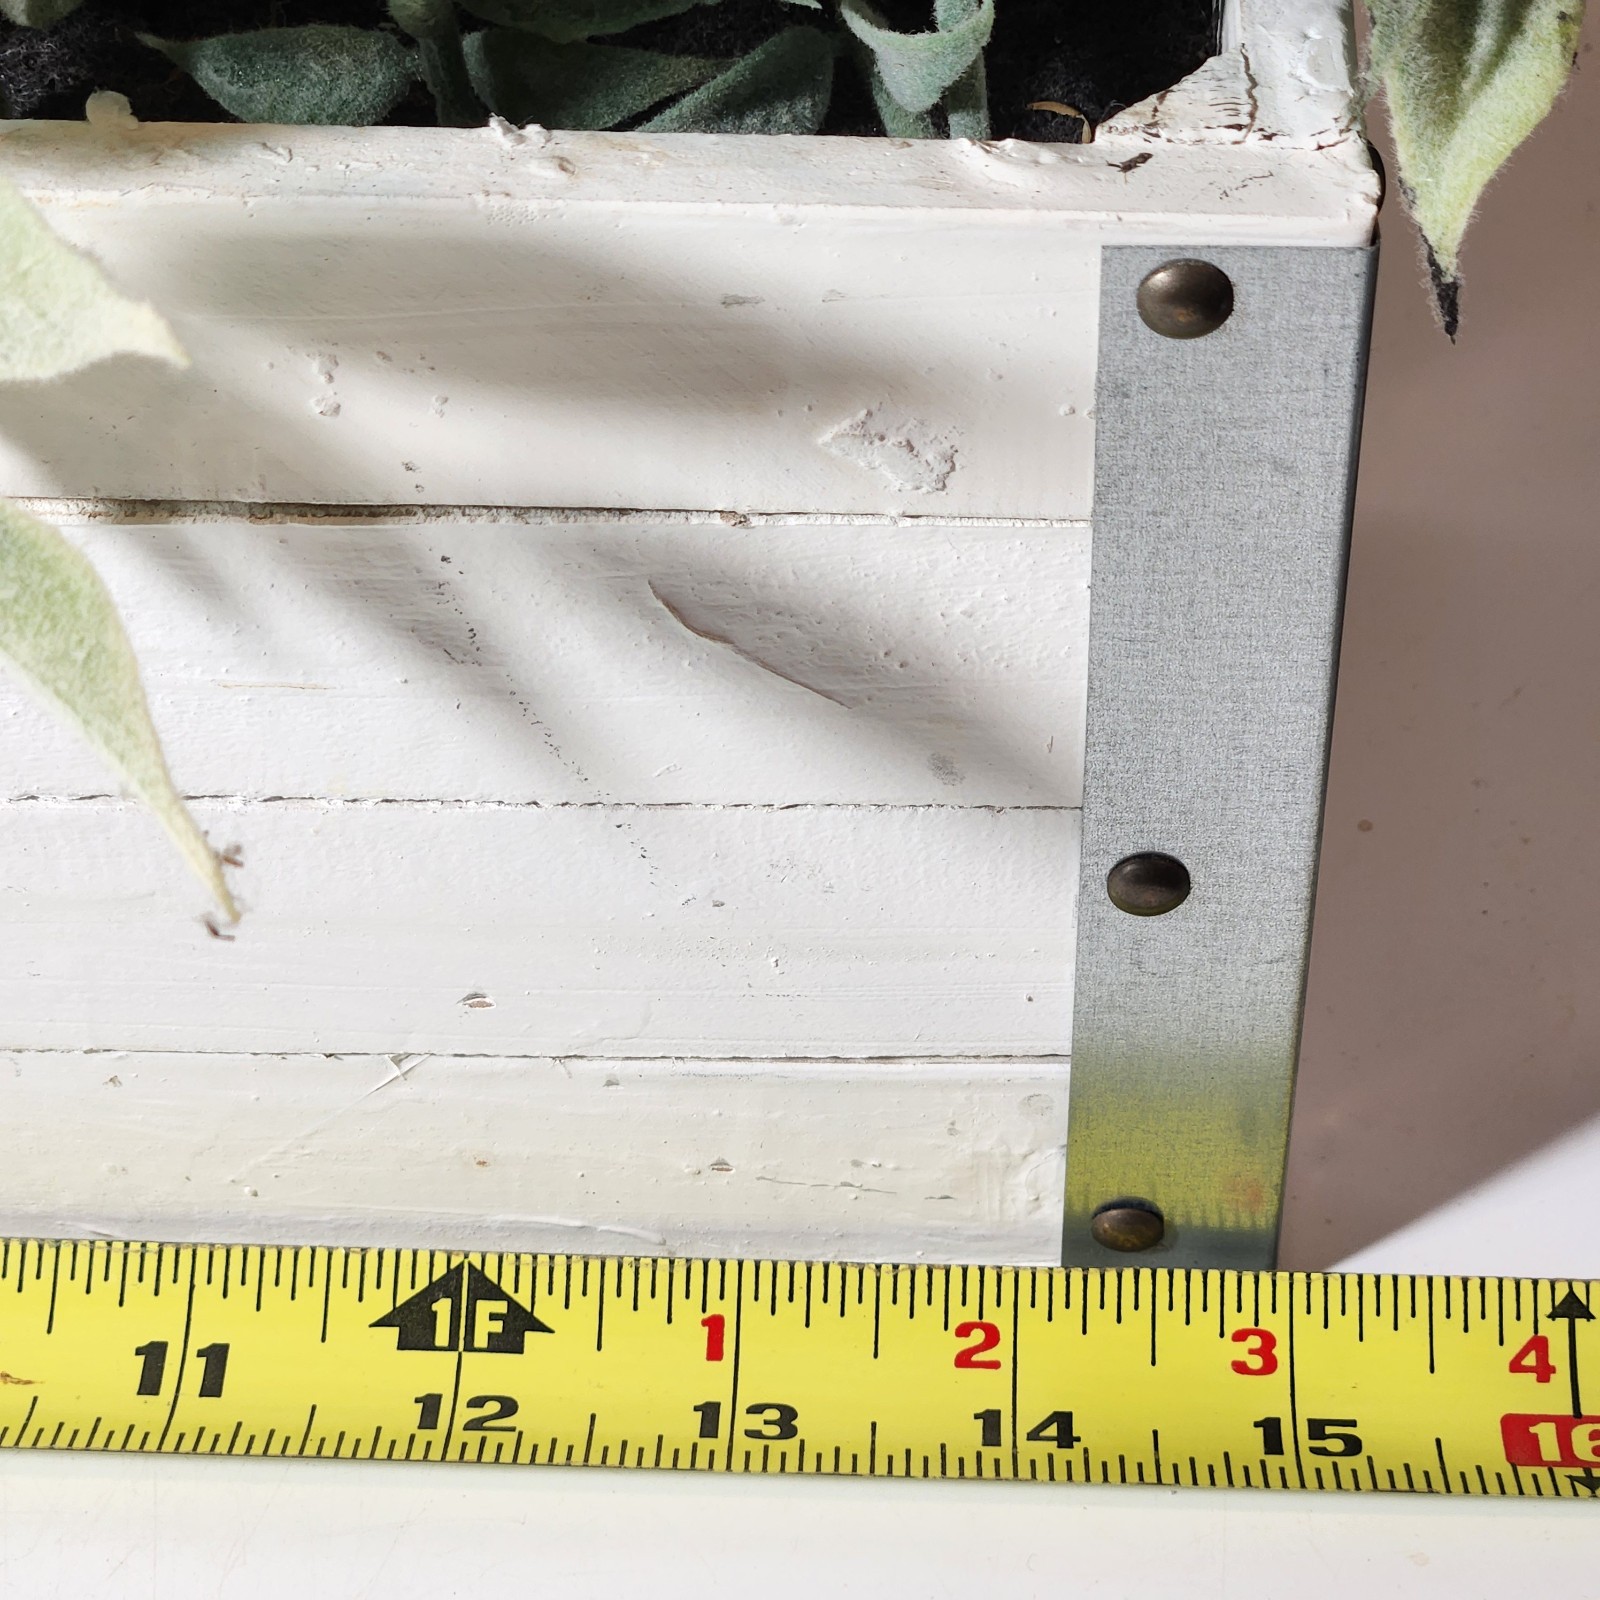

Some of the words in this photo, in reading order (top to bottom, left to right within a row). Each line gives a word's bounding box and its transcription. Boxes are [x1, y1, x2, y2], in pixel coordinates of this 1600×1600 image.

[702, 1314, 725, 1361] 1
[954, 1321, 1001, 1370] 2
[1231, 1328, 1278, 1376] 3
[1508, 1335, 1556, 1383] 4
[135, 1341, 230, 1398] 11
[414, 1393, 519, 1433] 12
[693, 1401, 799, 1440] 13
[973, 1408, 1082, 1449] 14
[1253, 1416, 1363, 1457] 15
